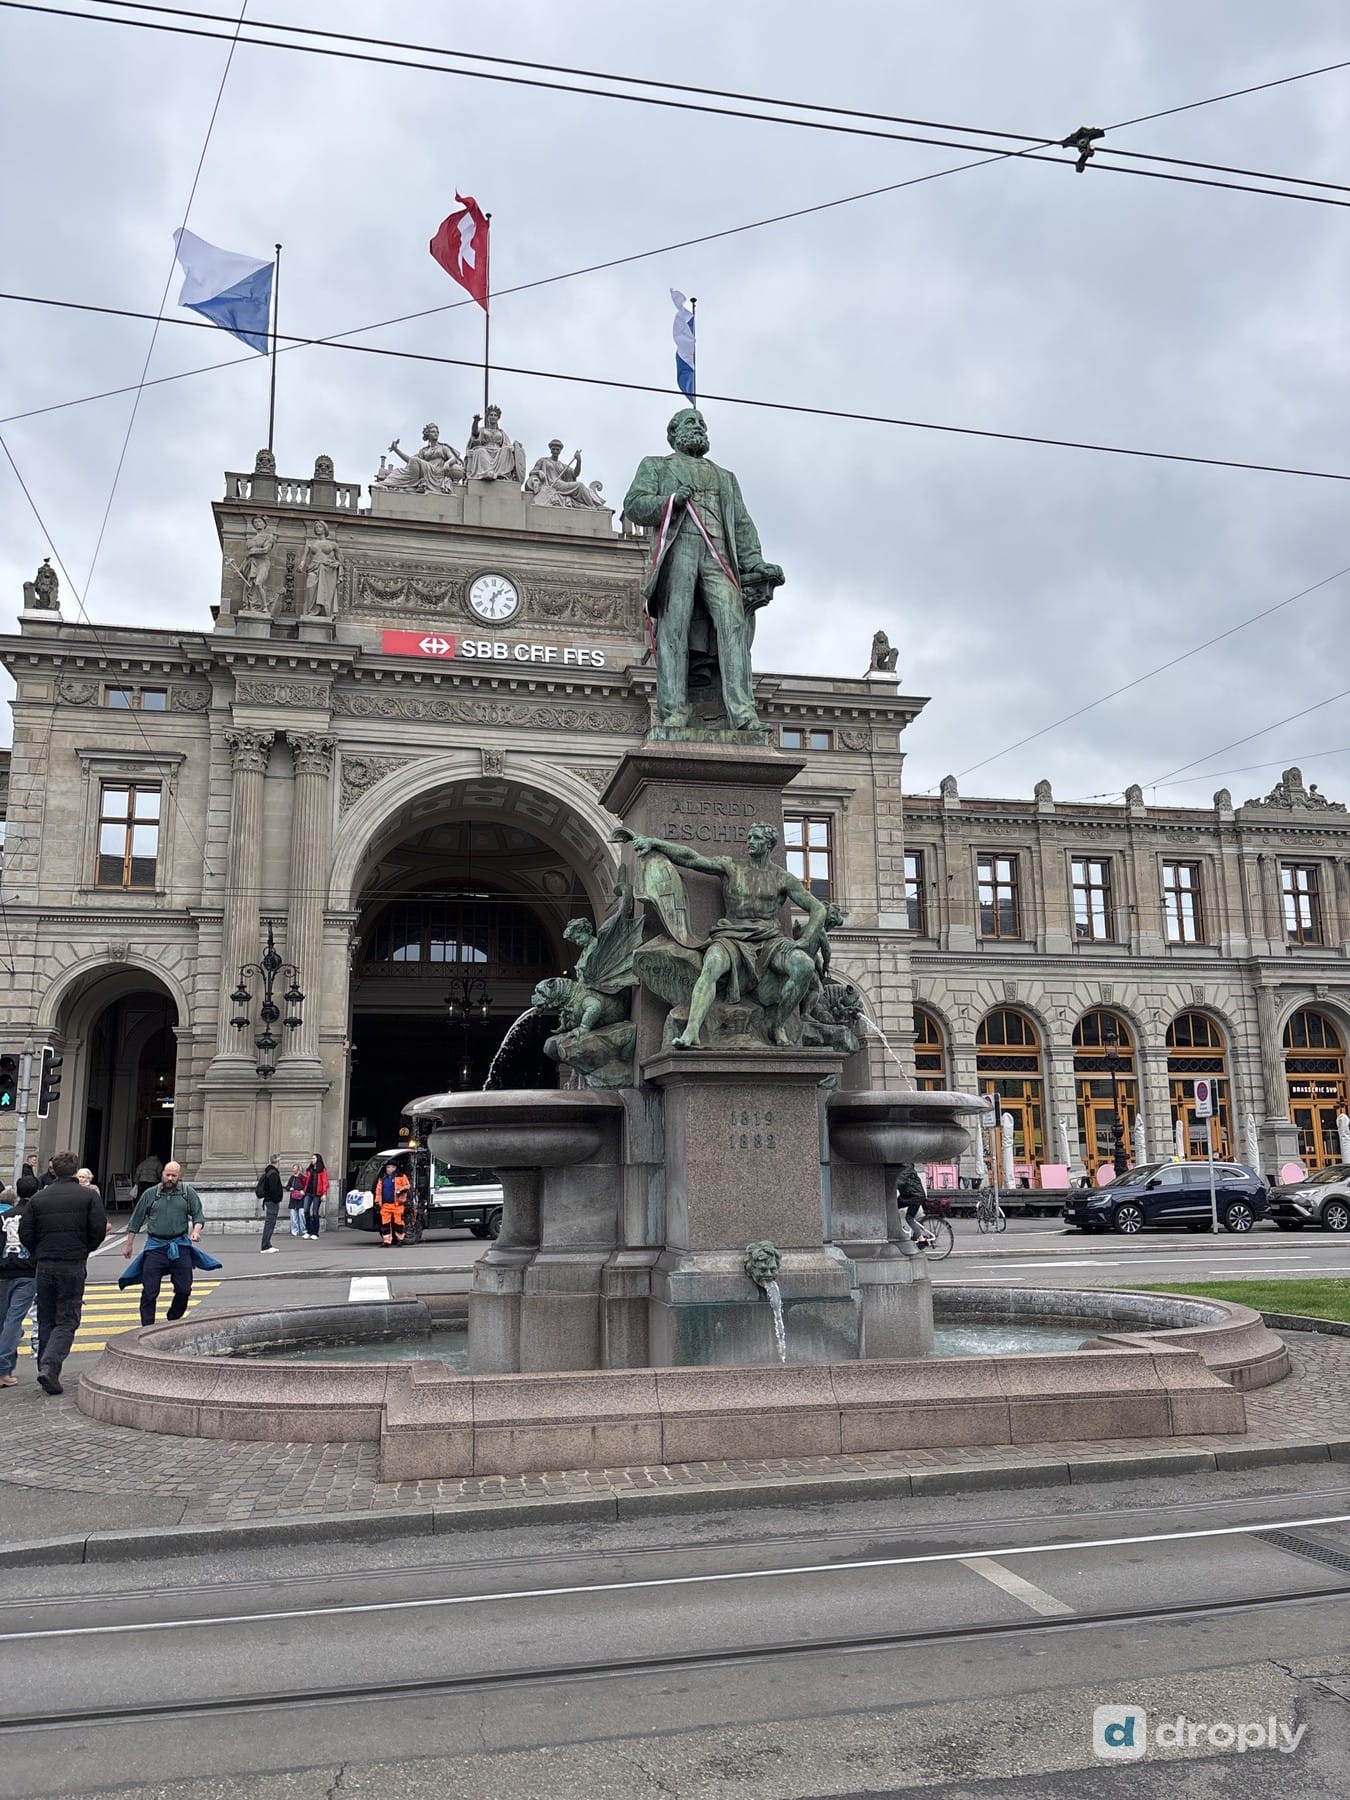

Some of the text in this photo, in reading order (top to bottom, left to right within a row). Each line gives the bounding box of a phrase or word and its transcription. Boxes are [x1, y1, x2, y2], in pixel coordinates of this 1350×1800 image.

[461, 640, 605, 667] SBB CFF FFS
[671, 799, 757, 817] ALFRED
[663, 823, 749, 843] ESCHE
[730, 1111, 773, 1126] 1819
[729, 1134, 777, 1149] 1882
